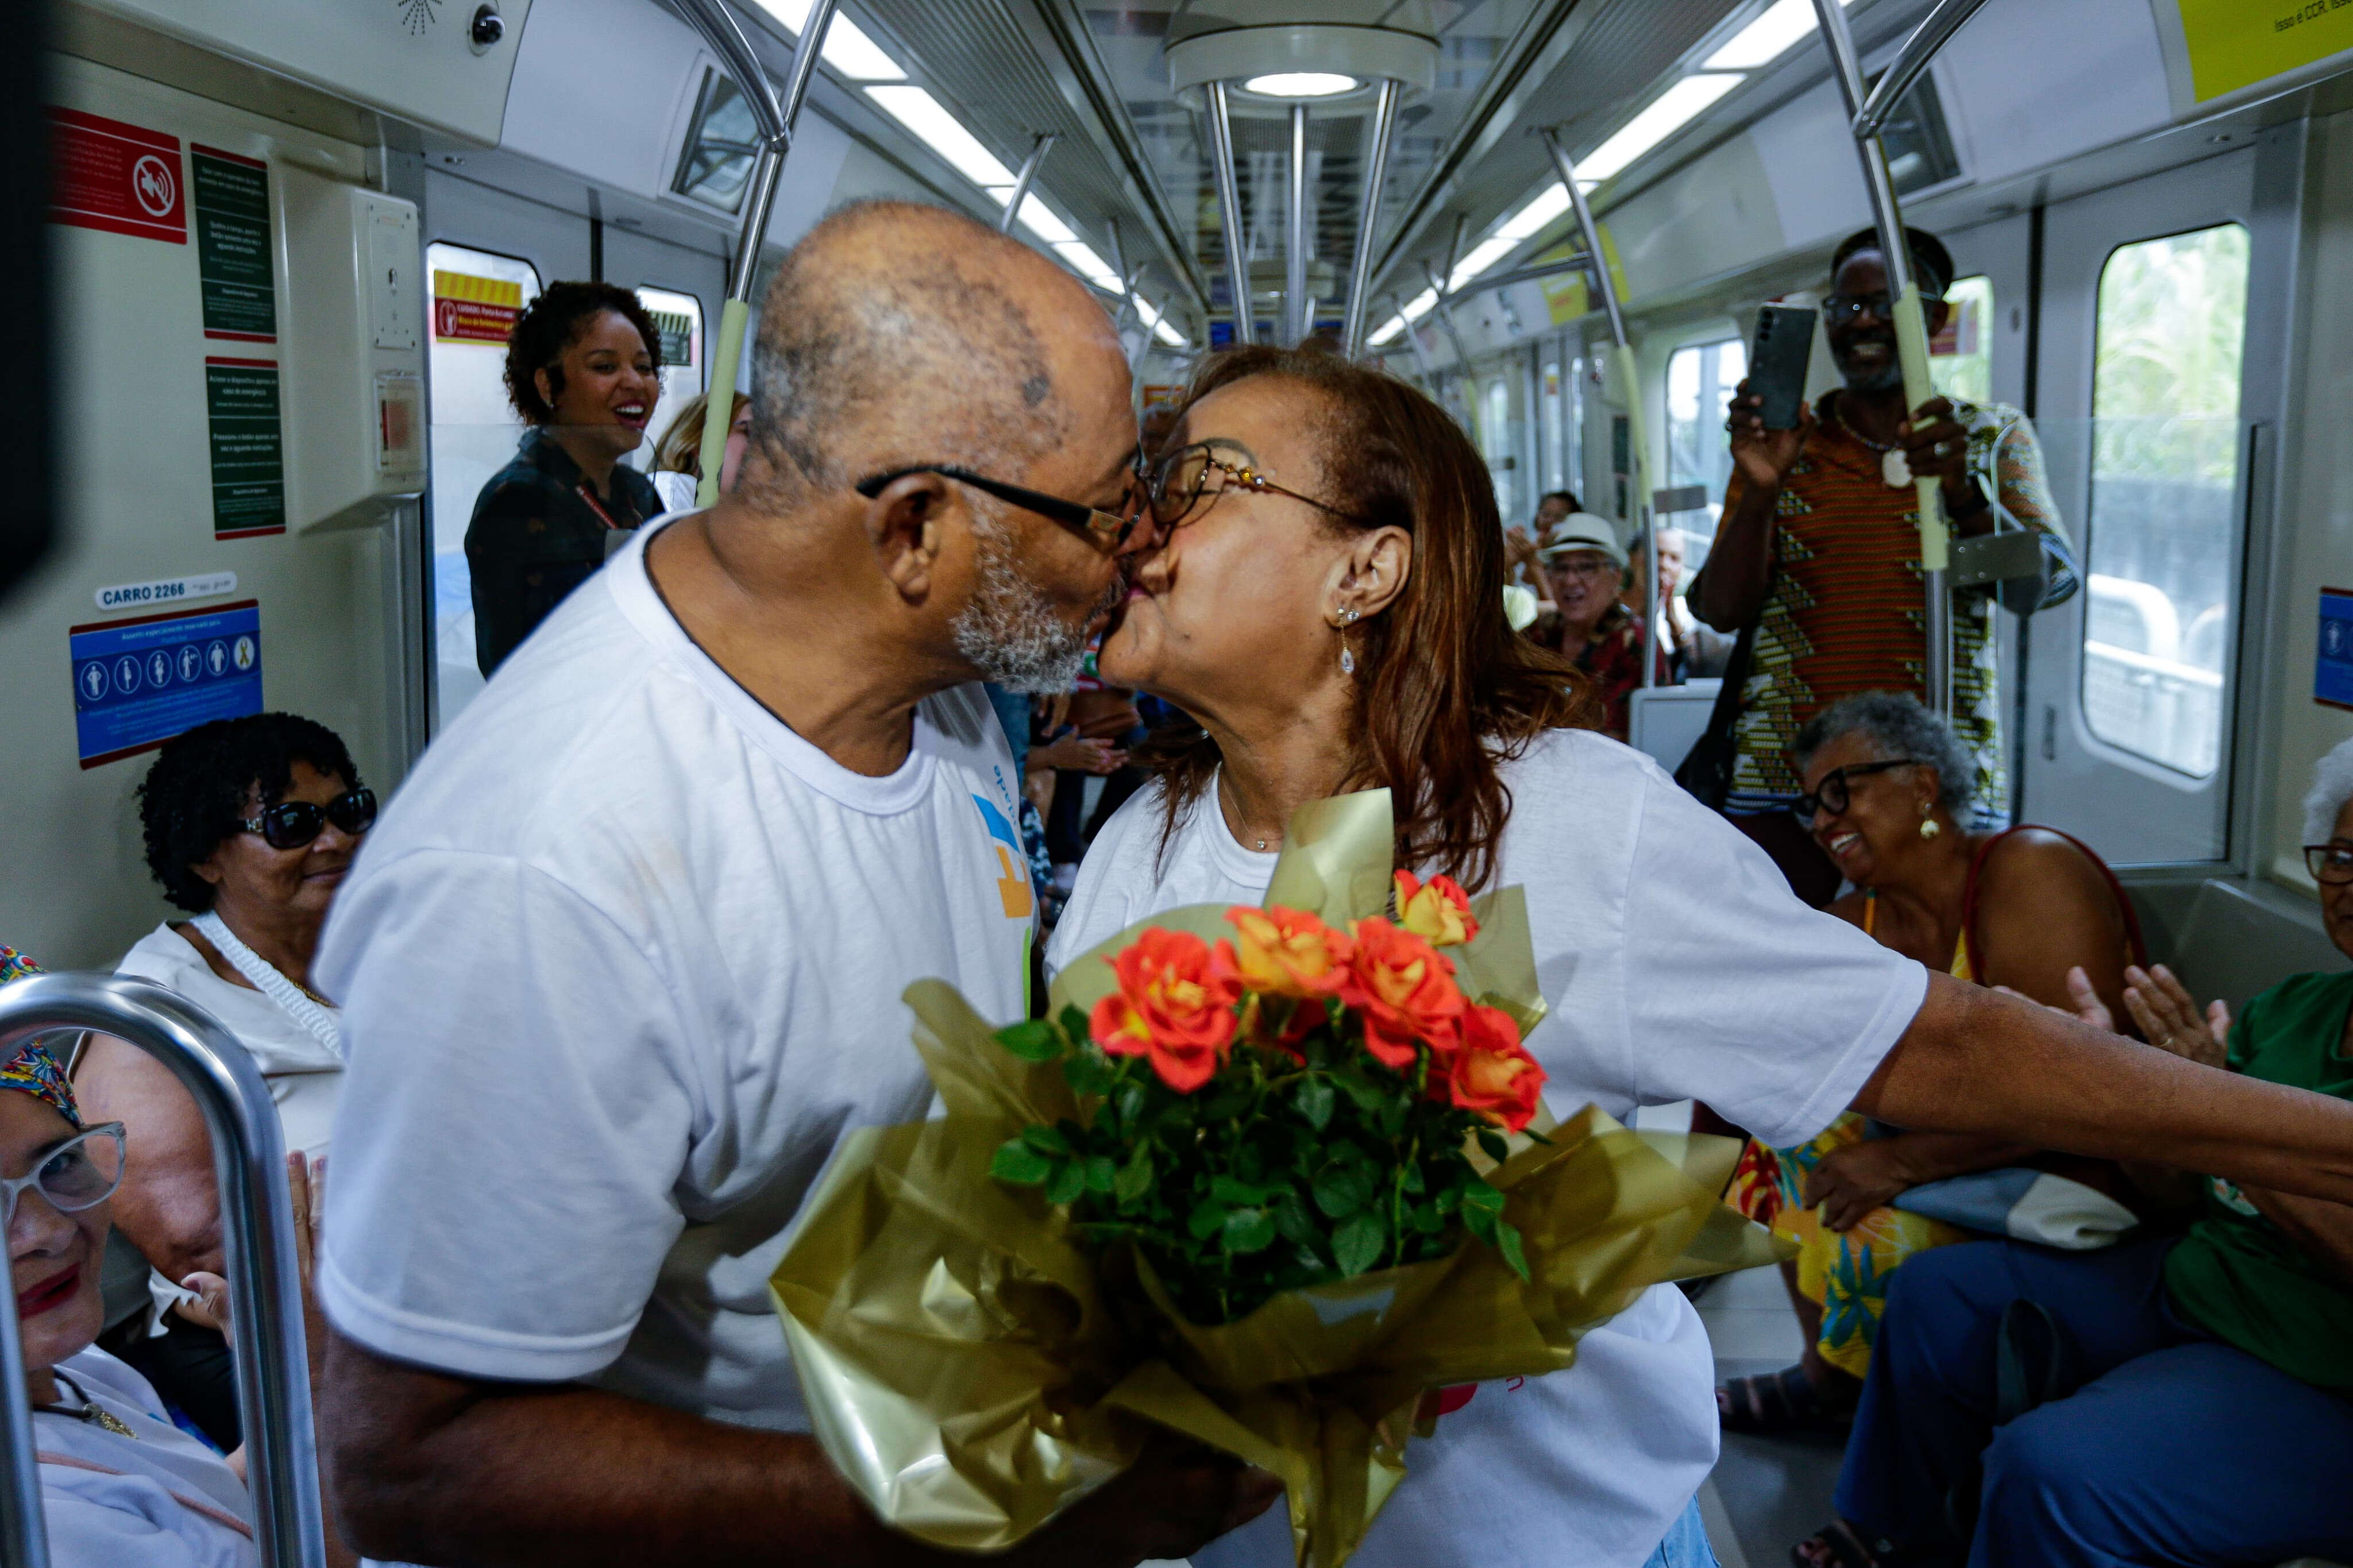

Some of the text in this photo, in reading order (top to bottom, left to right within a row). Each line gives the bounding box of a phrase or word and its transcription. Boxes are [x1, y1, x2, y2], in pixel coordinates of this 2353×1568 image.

[2275, 16, 2294, 32] Isso
[2297, 9, 2303, 24] é
[103, 586, 151, 605] CARRO
[155, 583, 185, 599] 2266
